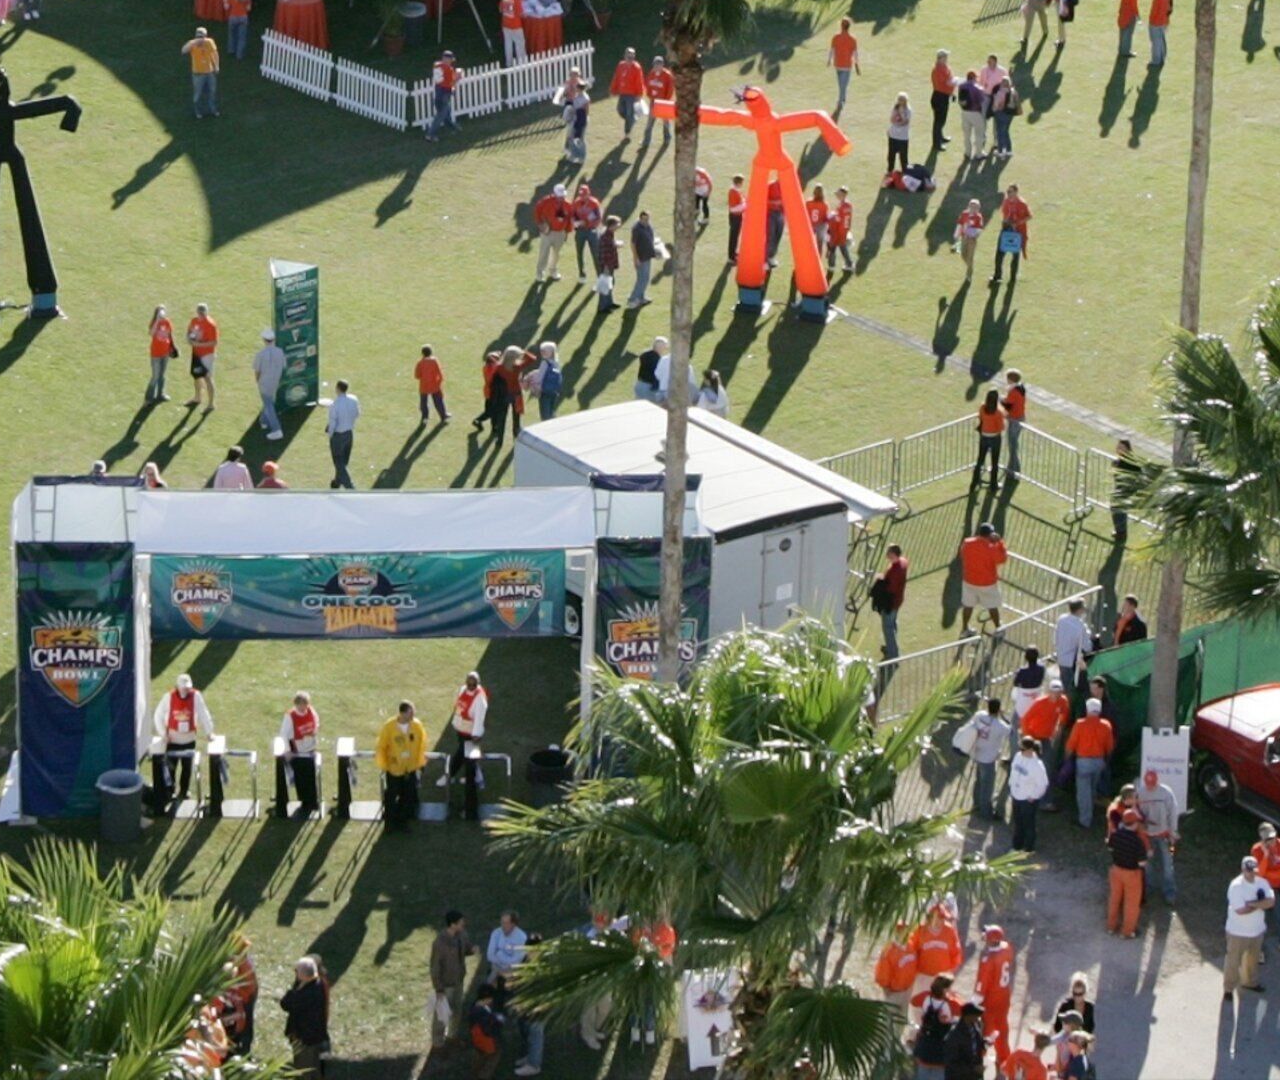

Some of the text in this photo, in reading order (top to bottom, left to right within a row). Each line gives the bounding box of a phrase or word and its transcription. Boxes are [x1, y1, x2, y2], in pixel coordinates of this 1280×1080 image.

[173, 588, 230, 604] CHAMPS
[301, 593, 417, 609] ONE COOL
[486, 583, 543, 601] CHAMPS
[323, 605, 397, 633] TAILGATE
[33, 647, 120, 668] CHAMPS
[609, 640, 695, 662] CHAS
[52, 669, 100, 680] BOWL
[999, 961, 1011, 989] 6
